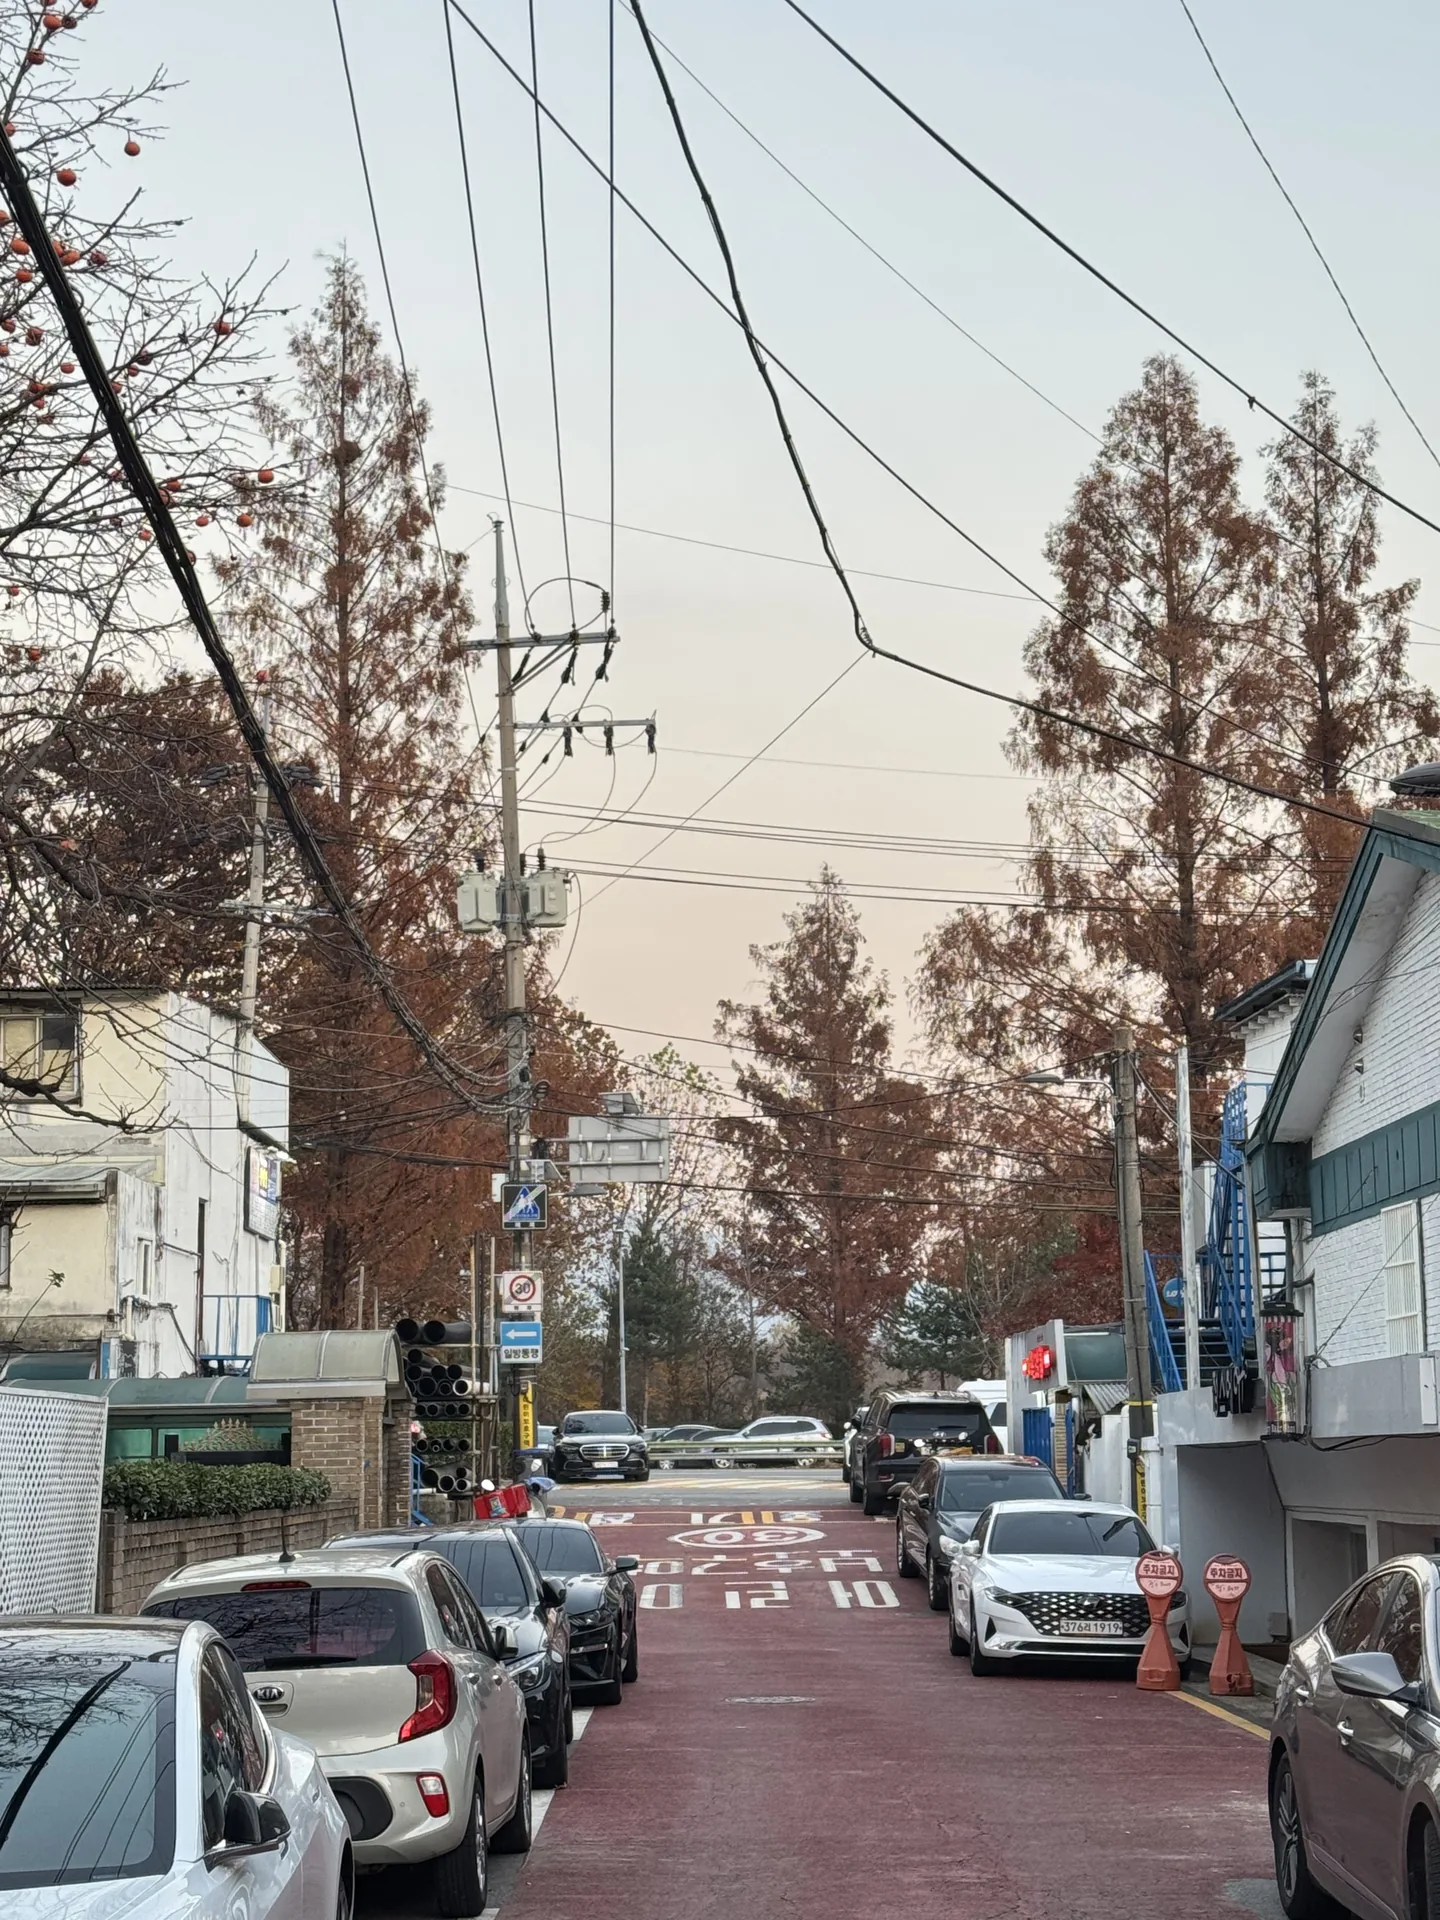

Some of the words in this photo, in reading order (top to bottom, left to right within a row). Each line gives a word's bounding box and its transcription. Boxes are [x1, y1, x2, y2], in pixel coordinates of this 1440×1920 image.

[515, 1282, 531, 1295] 30
[503, 1348, 539, 1360] 일방통행
[702, 1529, 799, 1544] 30
[1142, 1564, 1175, 1576] 주차금지
[1210, 1567, 1243, 1579] 주차금지
[1093, 1622, 1119, 1633] 1919
[256, 1688, 280, 1700] KIA
